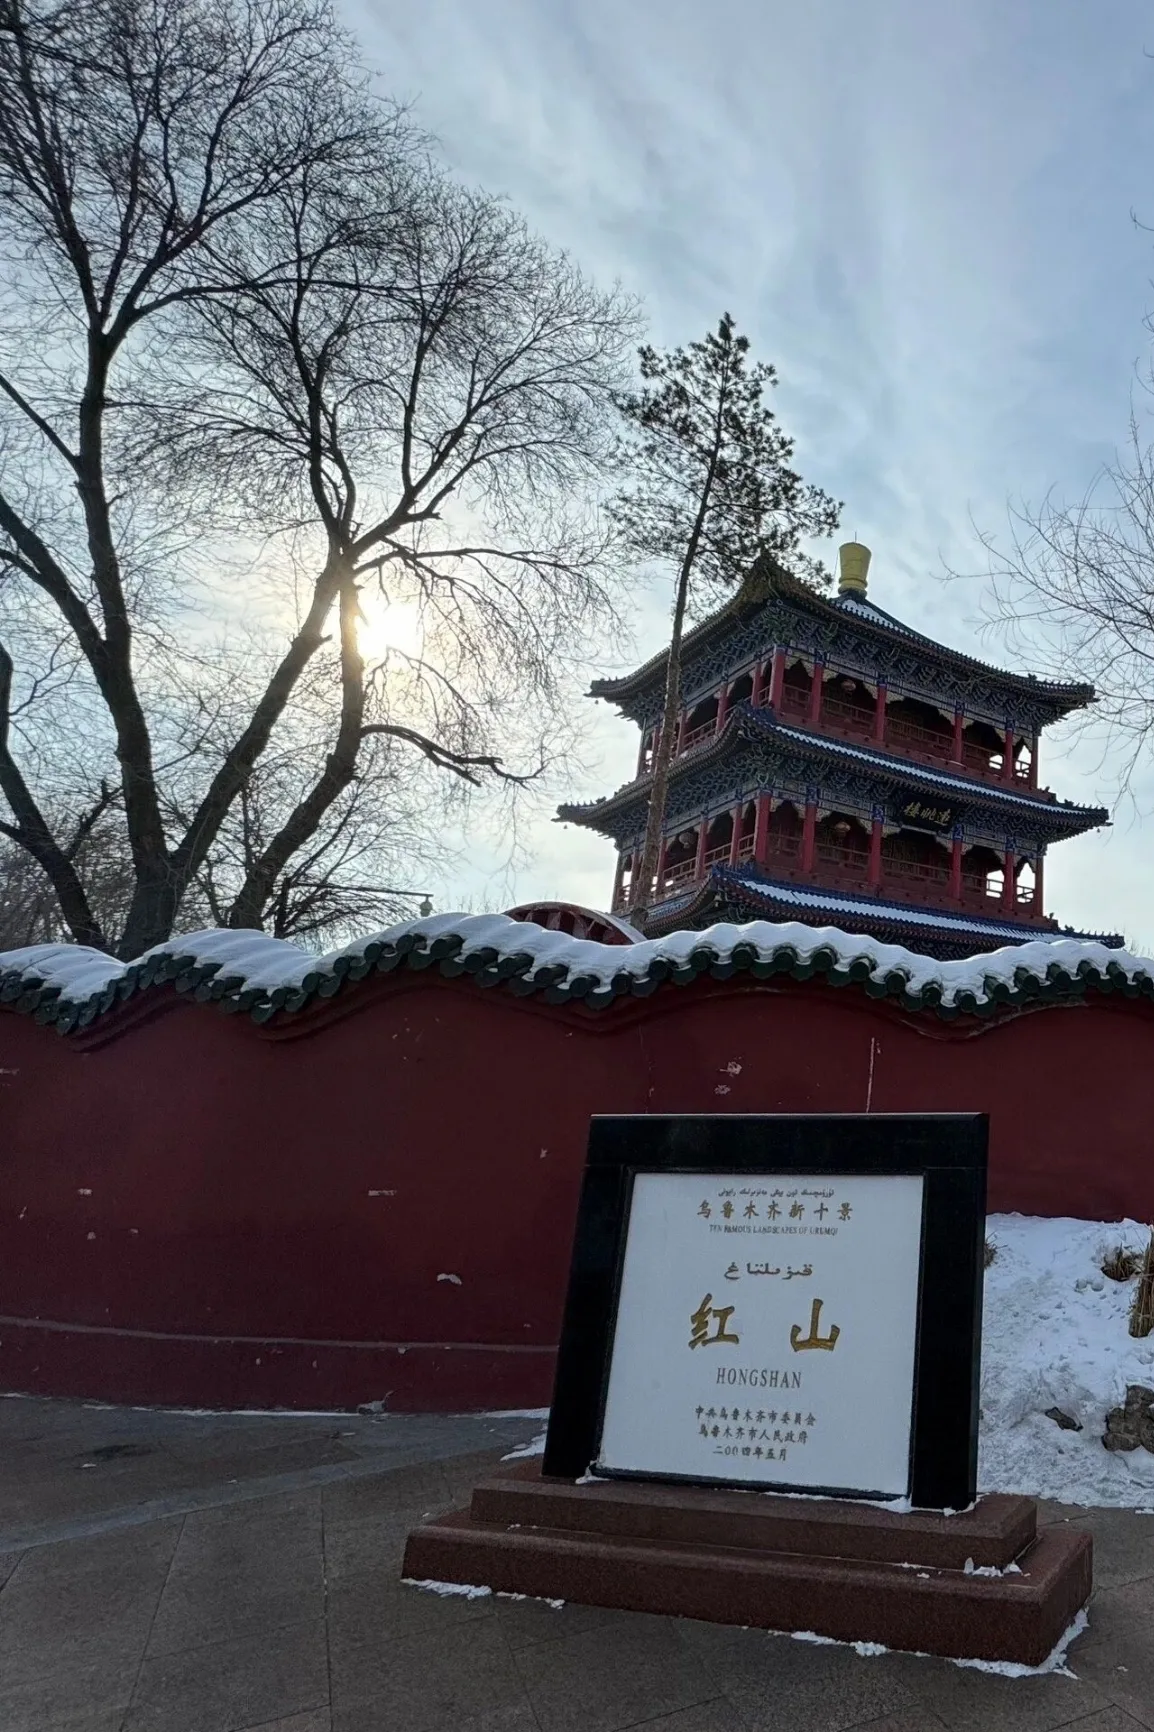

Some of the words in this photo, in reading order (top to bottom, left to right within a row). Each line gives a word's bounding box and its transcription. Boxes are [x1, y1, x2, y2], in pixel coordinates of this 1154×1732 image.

[697, 1200, 853, 1221] 乌鲁木齐新十景
[724, 1224, 751, 1234] FAMOUS
[753, 1225, 798, 1235] LANDSCAPES
[799, 1226, 808, 1235] OF
[688, 1293, 840, 1352] 红山
[716, 1367, 802, 1389] HONGSHAN
[695, 1405, 817, 1427] 中共乌鲁木齐市委员会
[698, 1424, 809, 1445] 乌鲁木齐市人民政府
